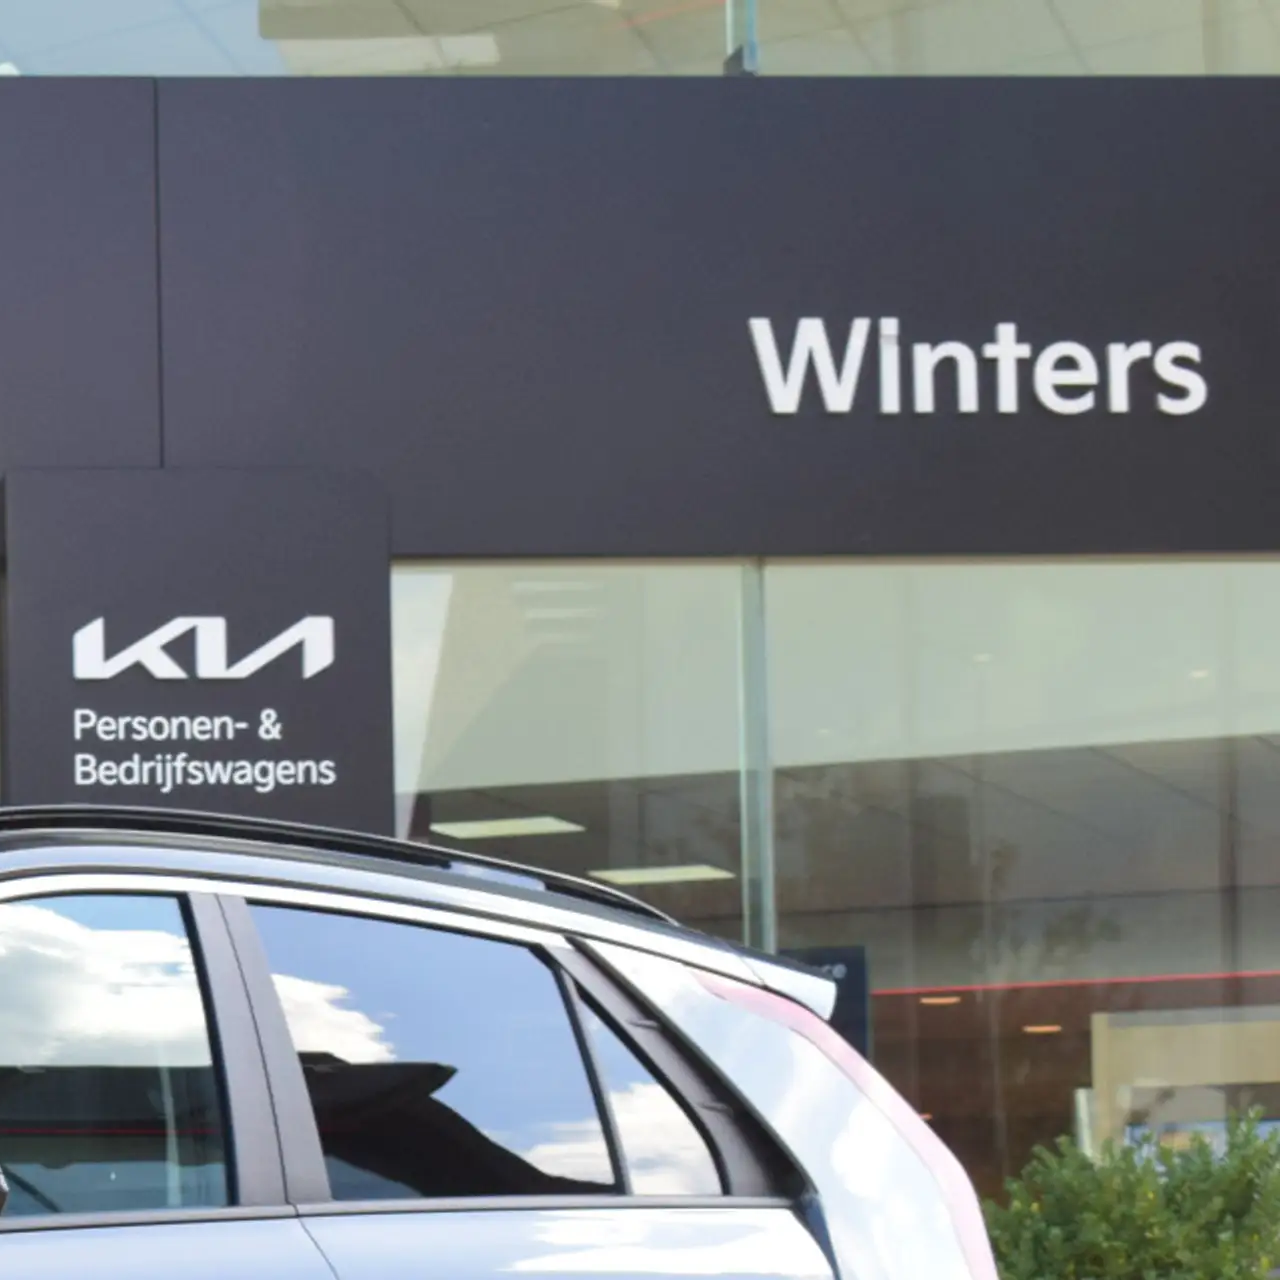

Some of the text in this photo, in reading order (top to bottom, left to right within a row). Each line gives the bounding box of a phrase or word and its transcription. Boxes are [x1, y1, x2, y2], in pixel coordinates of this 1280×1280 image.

[749, 317, 1207, 415] Winters
[72, 616, 335, 679] KIA
[74, 708, 282, 741] Personen- &
[74, 751, 336, 793] Bedrijfswagens
